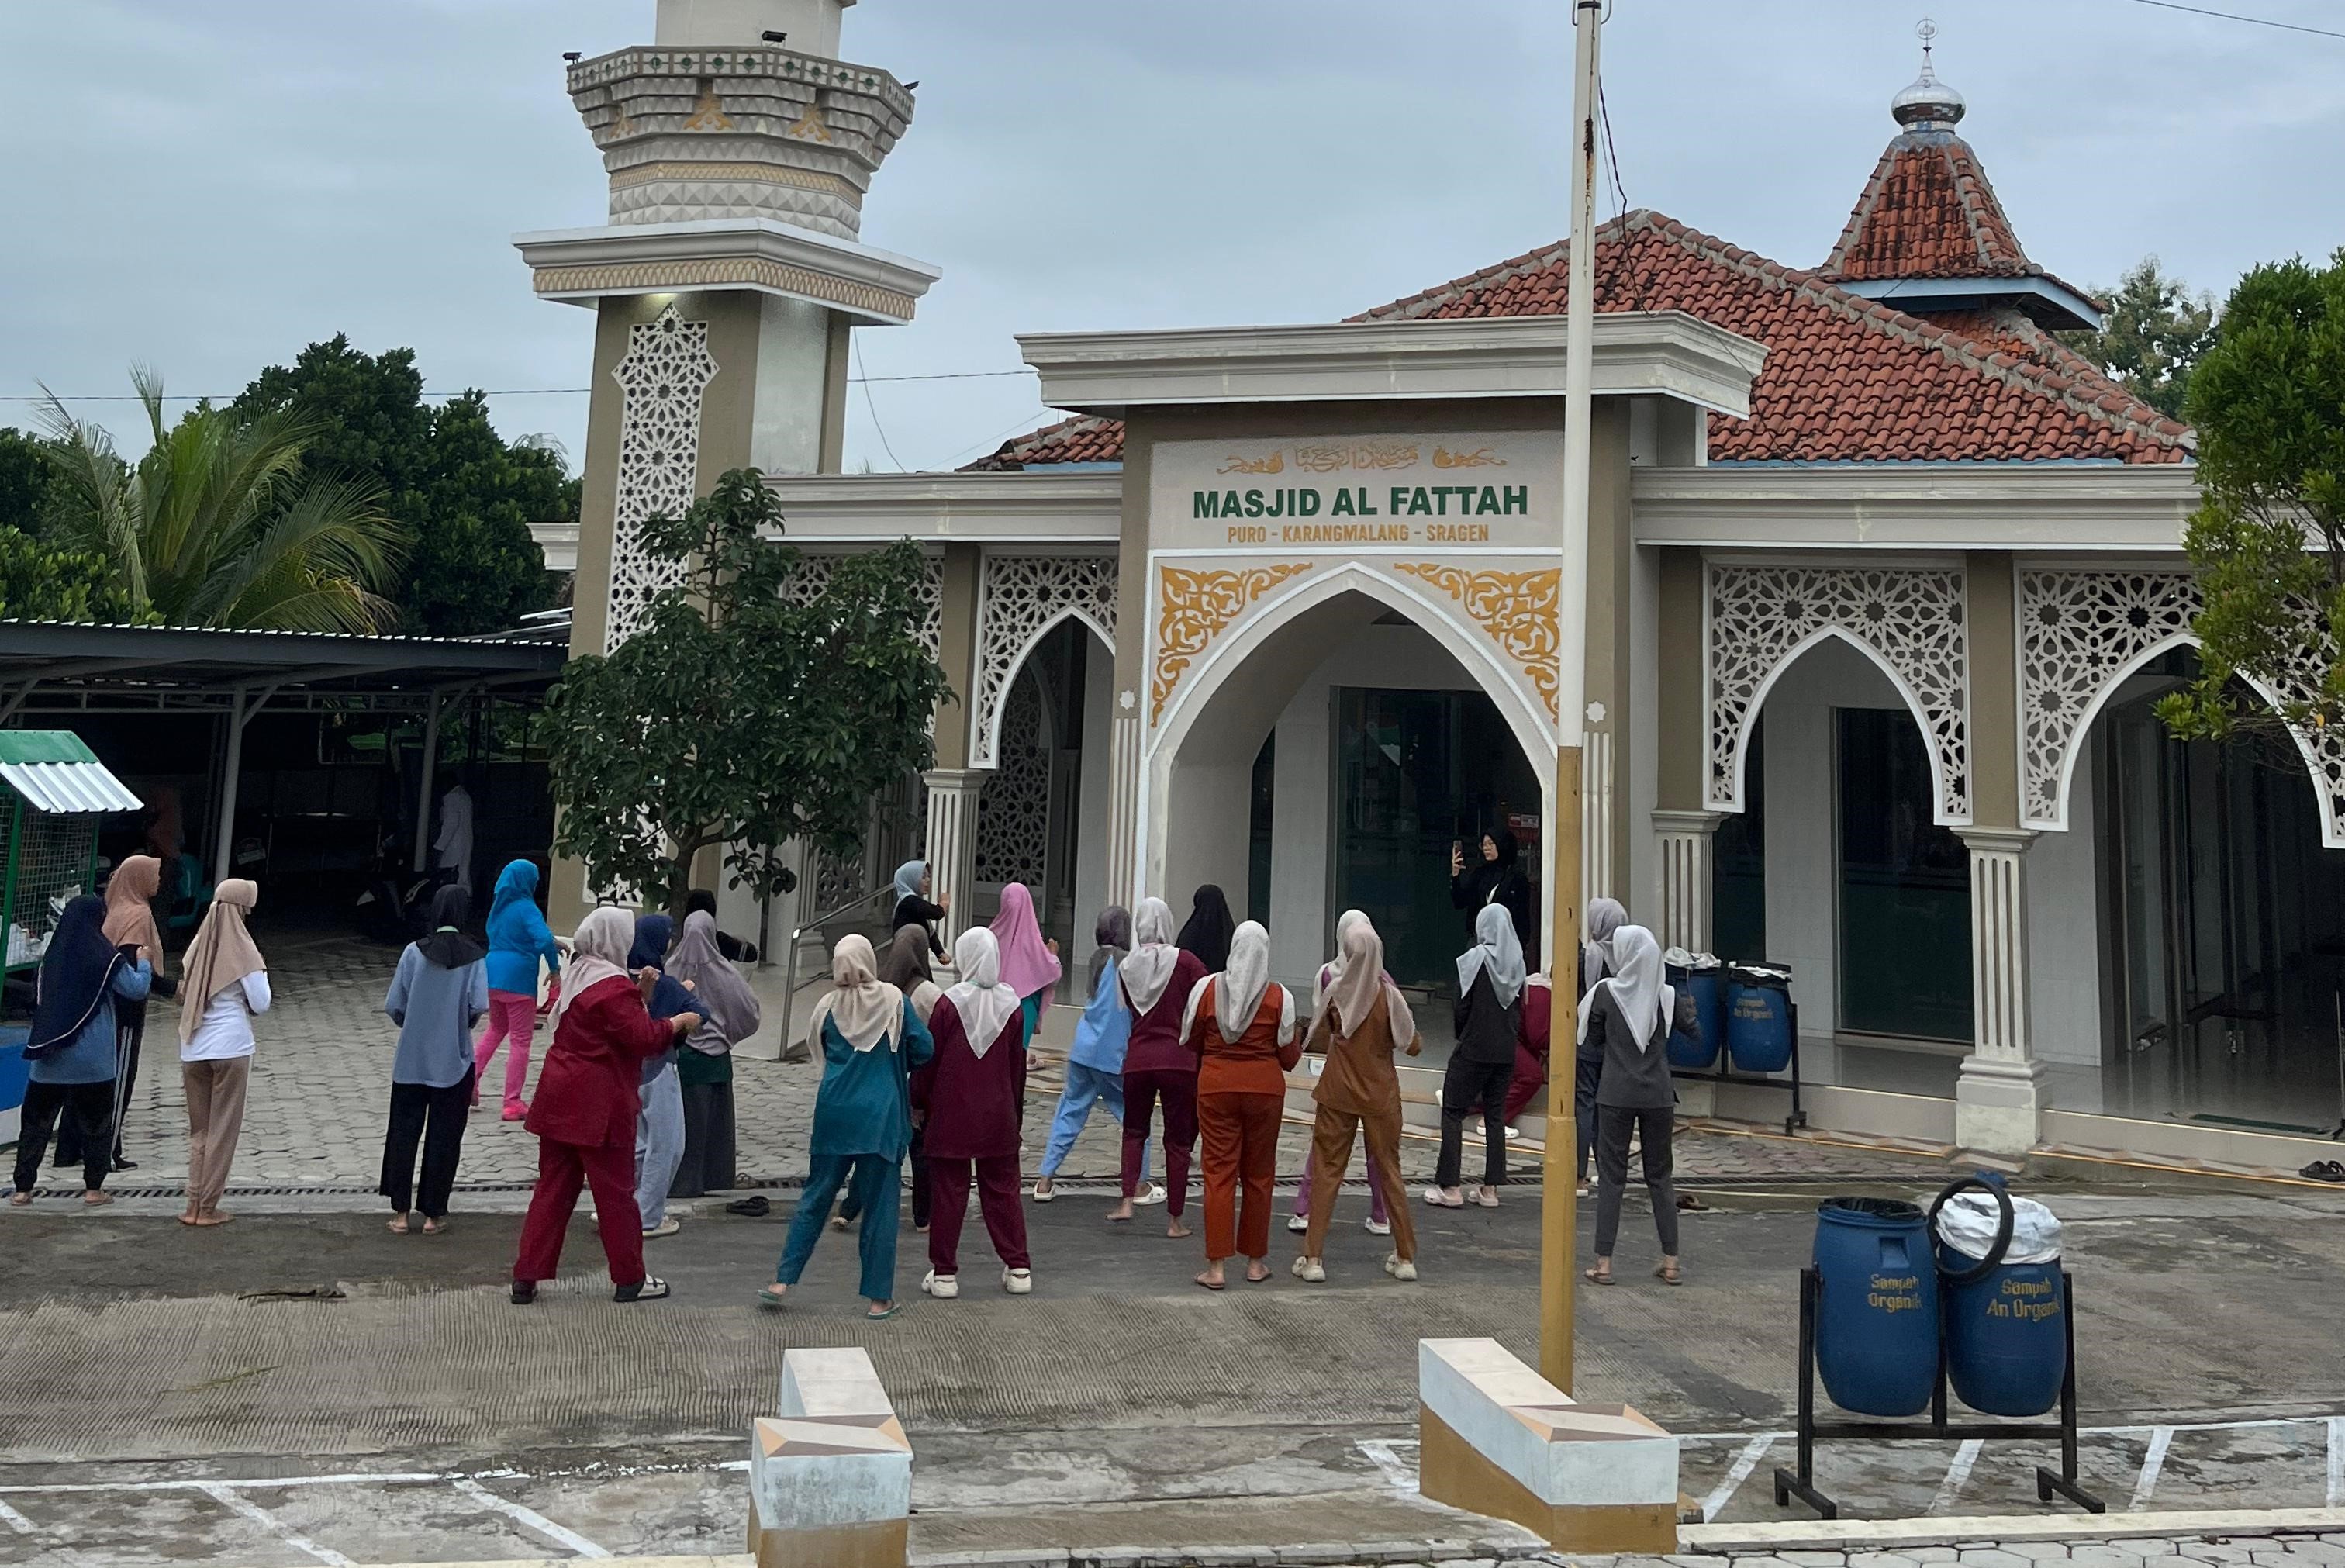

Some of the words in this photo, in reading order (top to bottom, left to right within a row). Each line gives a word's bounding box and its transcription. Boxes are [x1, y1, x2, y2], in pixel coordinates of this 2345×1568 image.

[1193, 489, 1321, 519] MASJID
[1331, 488, 1378, 516] AL
[1390, 485, 1528, 516] FATTAH
[1228, 526, 1266, 543] PURO
[1283, 524, 1409, 543] KARANGMALANG
[1427, 524, 1489, 542] SRAGEN
[1870, 1273, 1919, 1294] Sampah
[2001, 1276, 2052, 1299] Sampah
[1867, 1292, 1923, 1313] Organik
[1986, 1298, 2010, 1318] An
